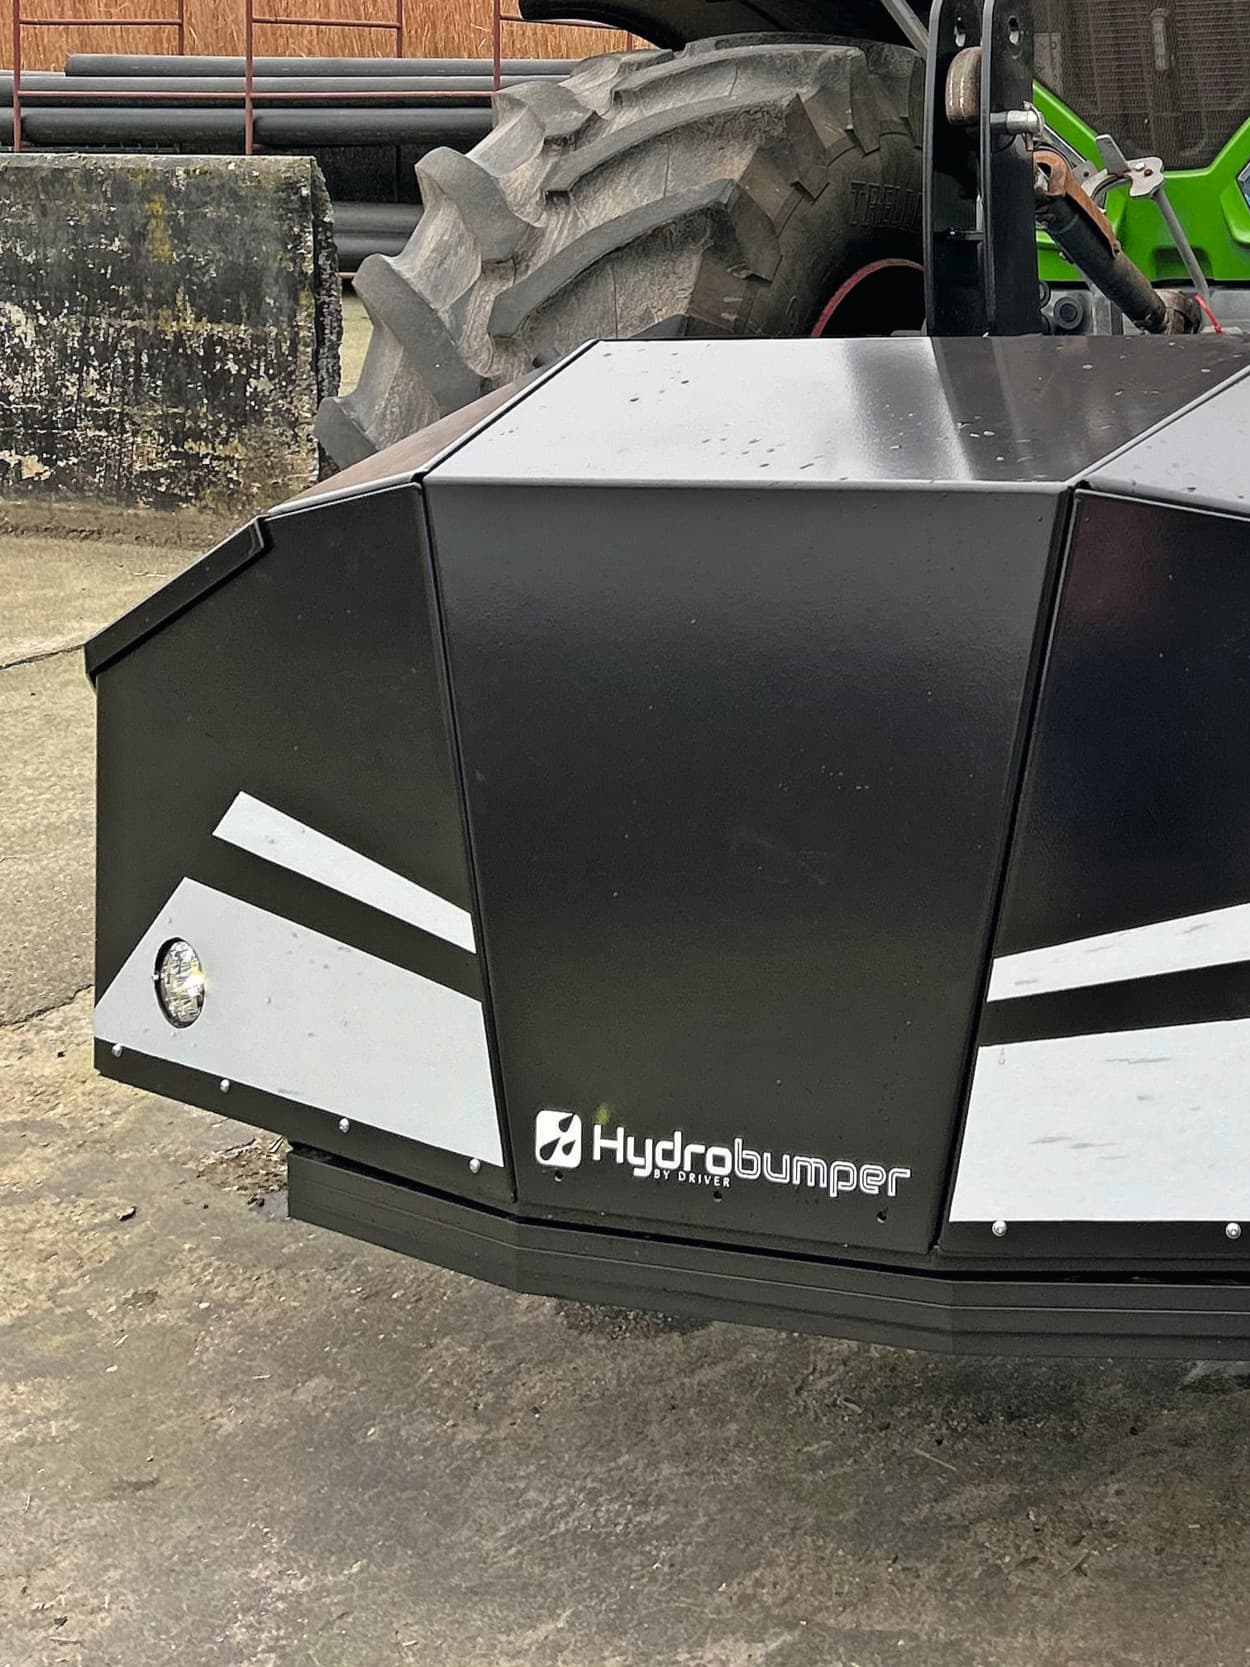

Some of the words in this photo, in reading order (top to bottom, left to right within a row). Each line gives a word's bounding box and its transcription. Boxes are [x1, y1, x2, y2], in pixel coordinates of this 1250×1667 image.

[849, 181, 923, 226] TRELL
[593, 1124, 911, 1197] Hydrobumper
[654, 1168, 670, 1180] BY
[678, 1170, 731, 1188] DRIVER
